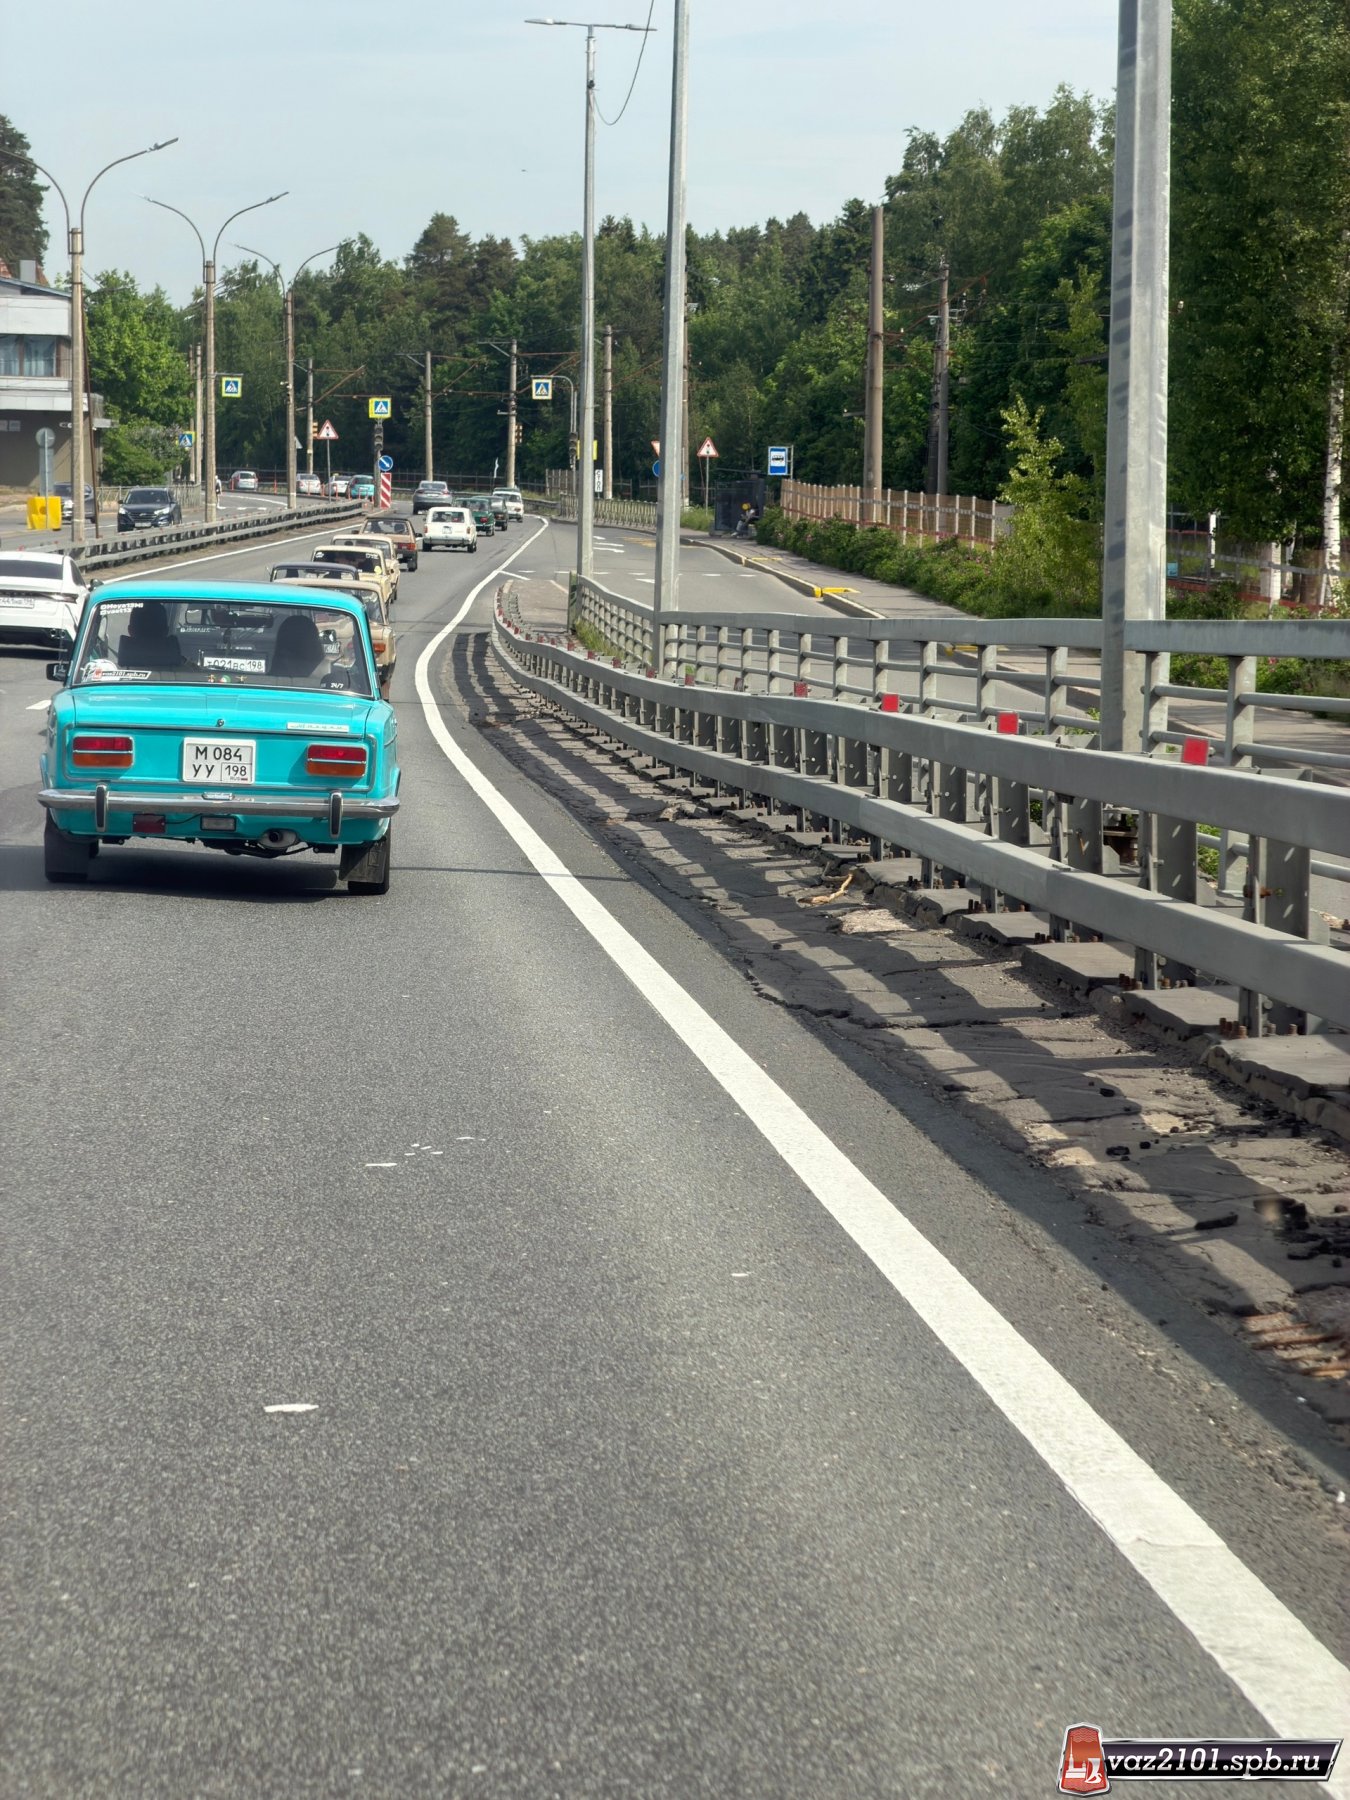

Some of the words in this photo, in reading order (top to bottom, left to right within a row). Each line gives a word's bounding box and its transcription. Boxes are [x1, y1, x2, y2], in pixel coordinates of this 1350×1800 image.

[247, 660, 264, 670] 198
[195, 746, 208, 760] М
[213, 747, 242, 762] 084
[225, 765, 247, 777] 198
